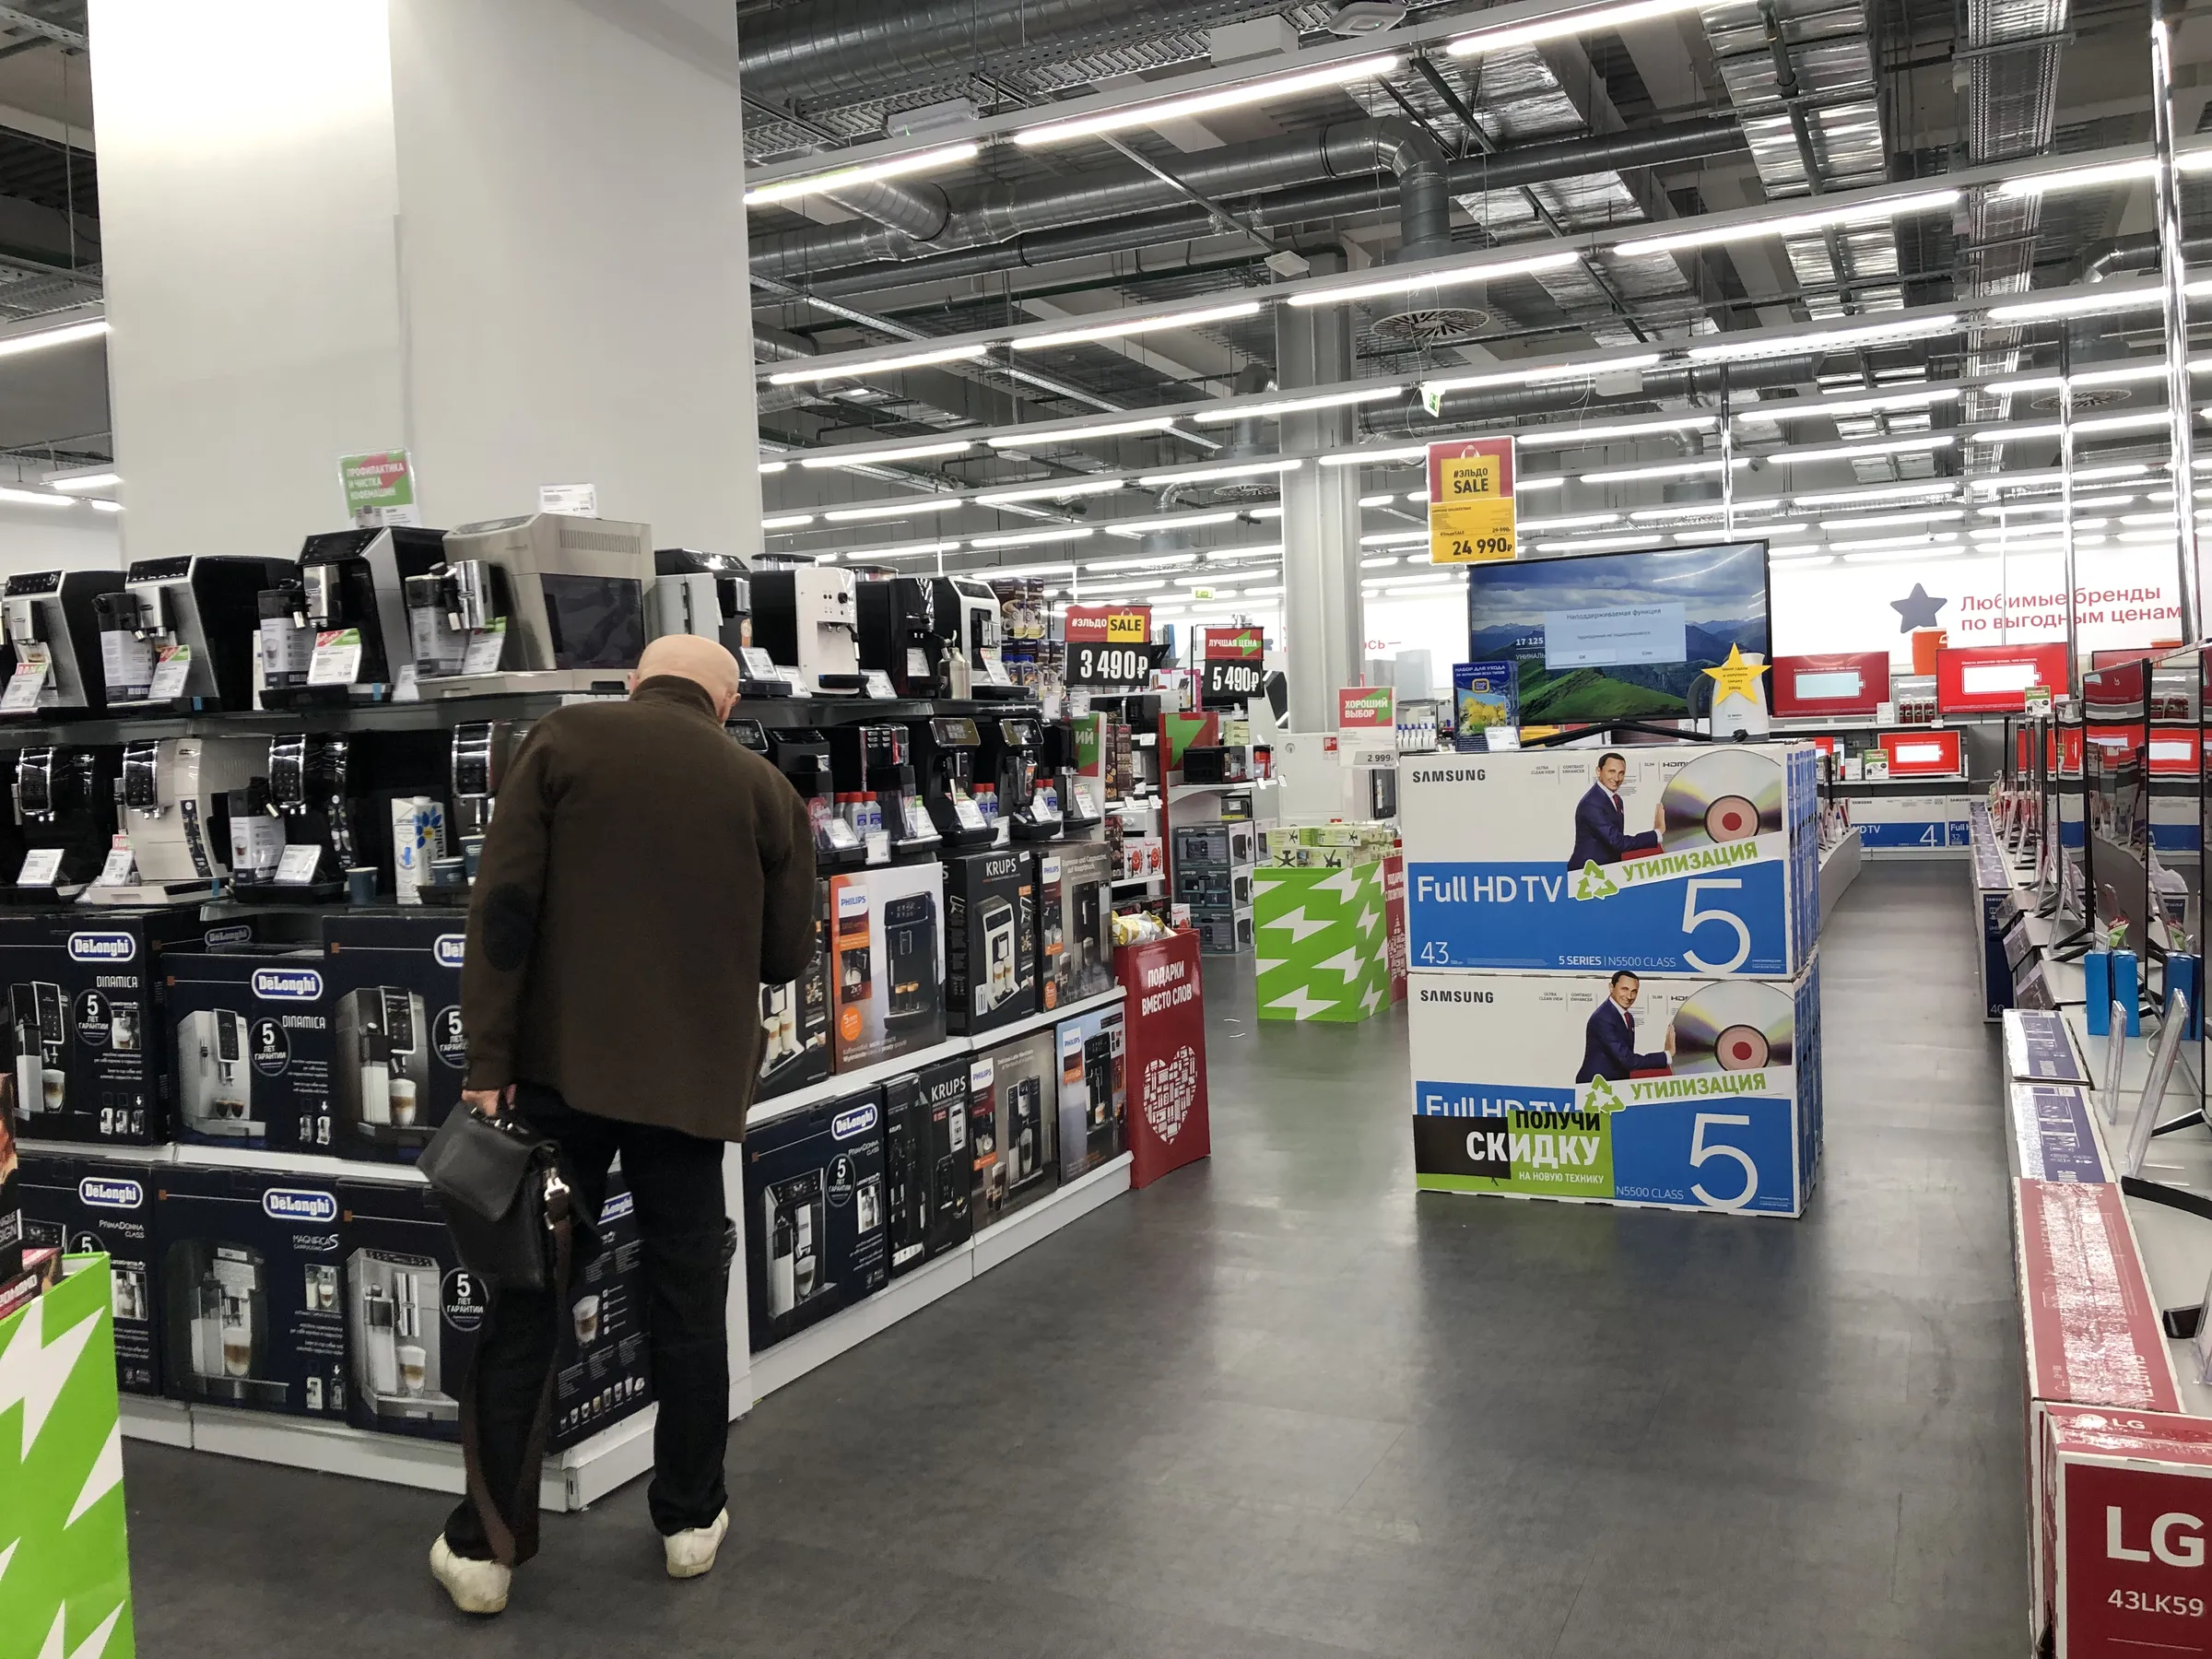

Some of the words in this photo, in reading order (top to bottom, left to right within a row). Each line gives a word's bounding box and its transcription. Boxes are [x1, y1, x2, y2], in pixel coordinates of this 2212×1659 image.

[1453, 467, 1488, 478] #ЭЛЬДО
[1453, 478, 1489, 494] SALE
[1453, 540, 1473, 556] 24
[1960, 593, 2066, 611] Любимые
[2074, 587, 2160, 606] бренды
[1072, 618, 1107, 629] #ЭЛЬДО
[1110, 619, 1142, 631] SALE
[1961, 618, 1986, 630] по
[1994, 610, 2104, 629] выгодным
[2112, 606, 2183, 624] ценам
[1208, 639, 1237, 647] ЛУЧШАЯ
[1239, 639, 1257, 649] ЦЕНА
[1515, 638, 1526, 646] 17
[1528, 637, 1544, 645] 125
[1080, 650, 1093, 678] 3
[1212, 666, 1222, 691] 5
[1345, 697, 1388, 709] ХОРОШИЙ
[1345, 709, 1375, 719] ВЫБОР
[1412, 769, 1486, 783] SAMSUNG
[1950, 823, 1965, 831] Full
[1919, 824, 1937, 847] 4
[985, 858, 1017, 877] KRUPS
[1043, 865, 1059, 874] PHILIPS
[1622, 841, 1759, 882] УТИЛИЗАЦИЯ
[1417, 876, 1467, 902] Full
[1473, 876, 1517, 902] HD
[1520, 876, 1563, 903] TV
[841, 895, 866, 906] PHILIPS
[1682, 878, 1751, 974] 5
[1420, 941, 1450, 965] 43
[1559, 956, 1565, 965] 5
[1566, 956, 1602, 966] SERIES
[1607, 957, 1641, 967] N5500
[1643, 957, 1677, 967] CLASS
[96, 975, 138, 988] DINAMICA
[1147, 960, 1184, 988] ПОДАРКИ
[87, 994, 99, 1015] 5
[1142, 994, 1171, 1017] ВМЕСТО
[1172, 986, 1193, 1006] СЛОВ
[1420, 990, 1494, 1005] SAMSUNG
[282, 1015, 325, 1030] DINAMICA
[449, 1011, 463, 1035] 5
[262, 1023, 275, 1045] 5
[1064, 1036, 1081, 1048] PHILIPS
[254, 1052, 287, 1061] ГАРАНТИИ
[264, 1044, 276, 1053] ЛЕТ
[972, 1068, 992, 1081] PHILIPS
[931, 1076, 966, 1102] KRUPS
[1630, 1073, 1767, 1100] УТИЛИЗАЦИЯ
[1515, 1110, 1601, 1132] ПОЛУЧИ
[1465, 1131, 1601, 1169] СКИДКУ
[1689, 1112, 1759, 1208] 5
[837, 1158, 846, 1179] 5
[1519, 1171, 1531, 1181] НА
[1533, 1171, 1563, 1182] НОВУЮ
[1565, 1173, 1605, 1183] ТЕХНИКУ
[1616, 1186, 1649, 1197] N5500
[1651, 1188, 1684, 1199] CLASS
[81, 1236, 93, 1253] 5
[456, 1274, 470, 1297] 5
[447, 1304, 484, 1313] ГАРАНТИИ
[457, 1297, 471, 1305] ЛЕТ
[2112, 1418, 2146, 1430] LG
[2107, 1505, 2205, 1568] LG
[2107, 1589, 2205, 1617] 43LK59
